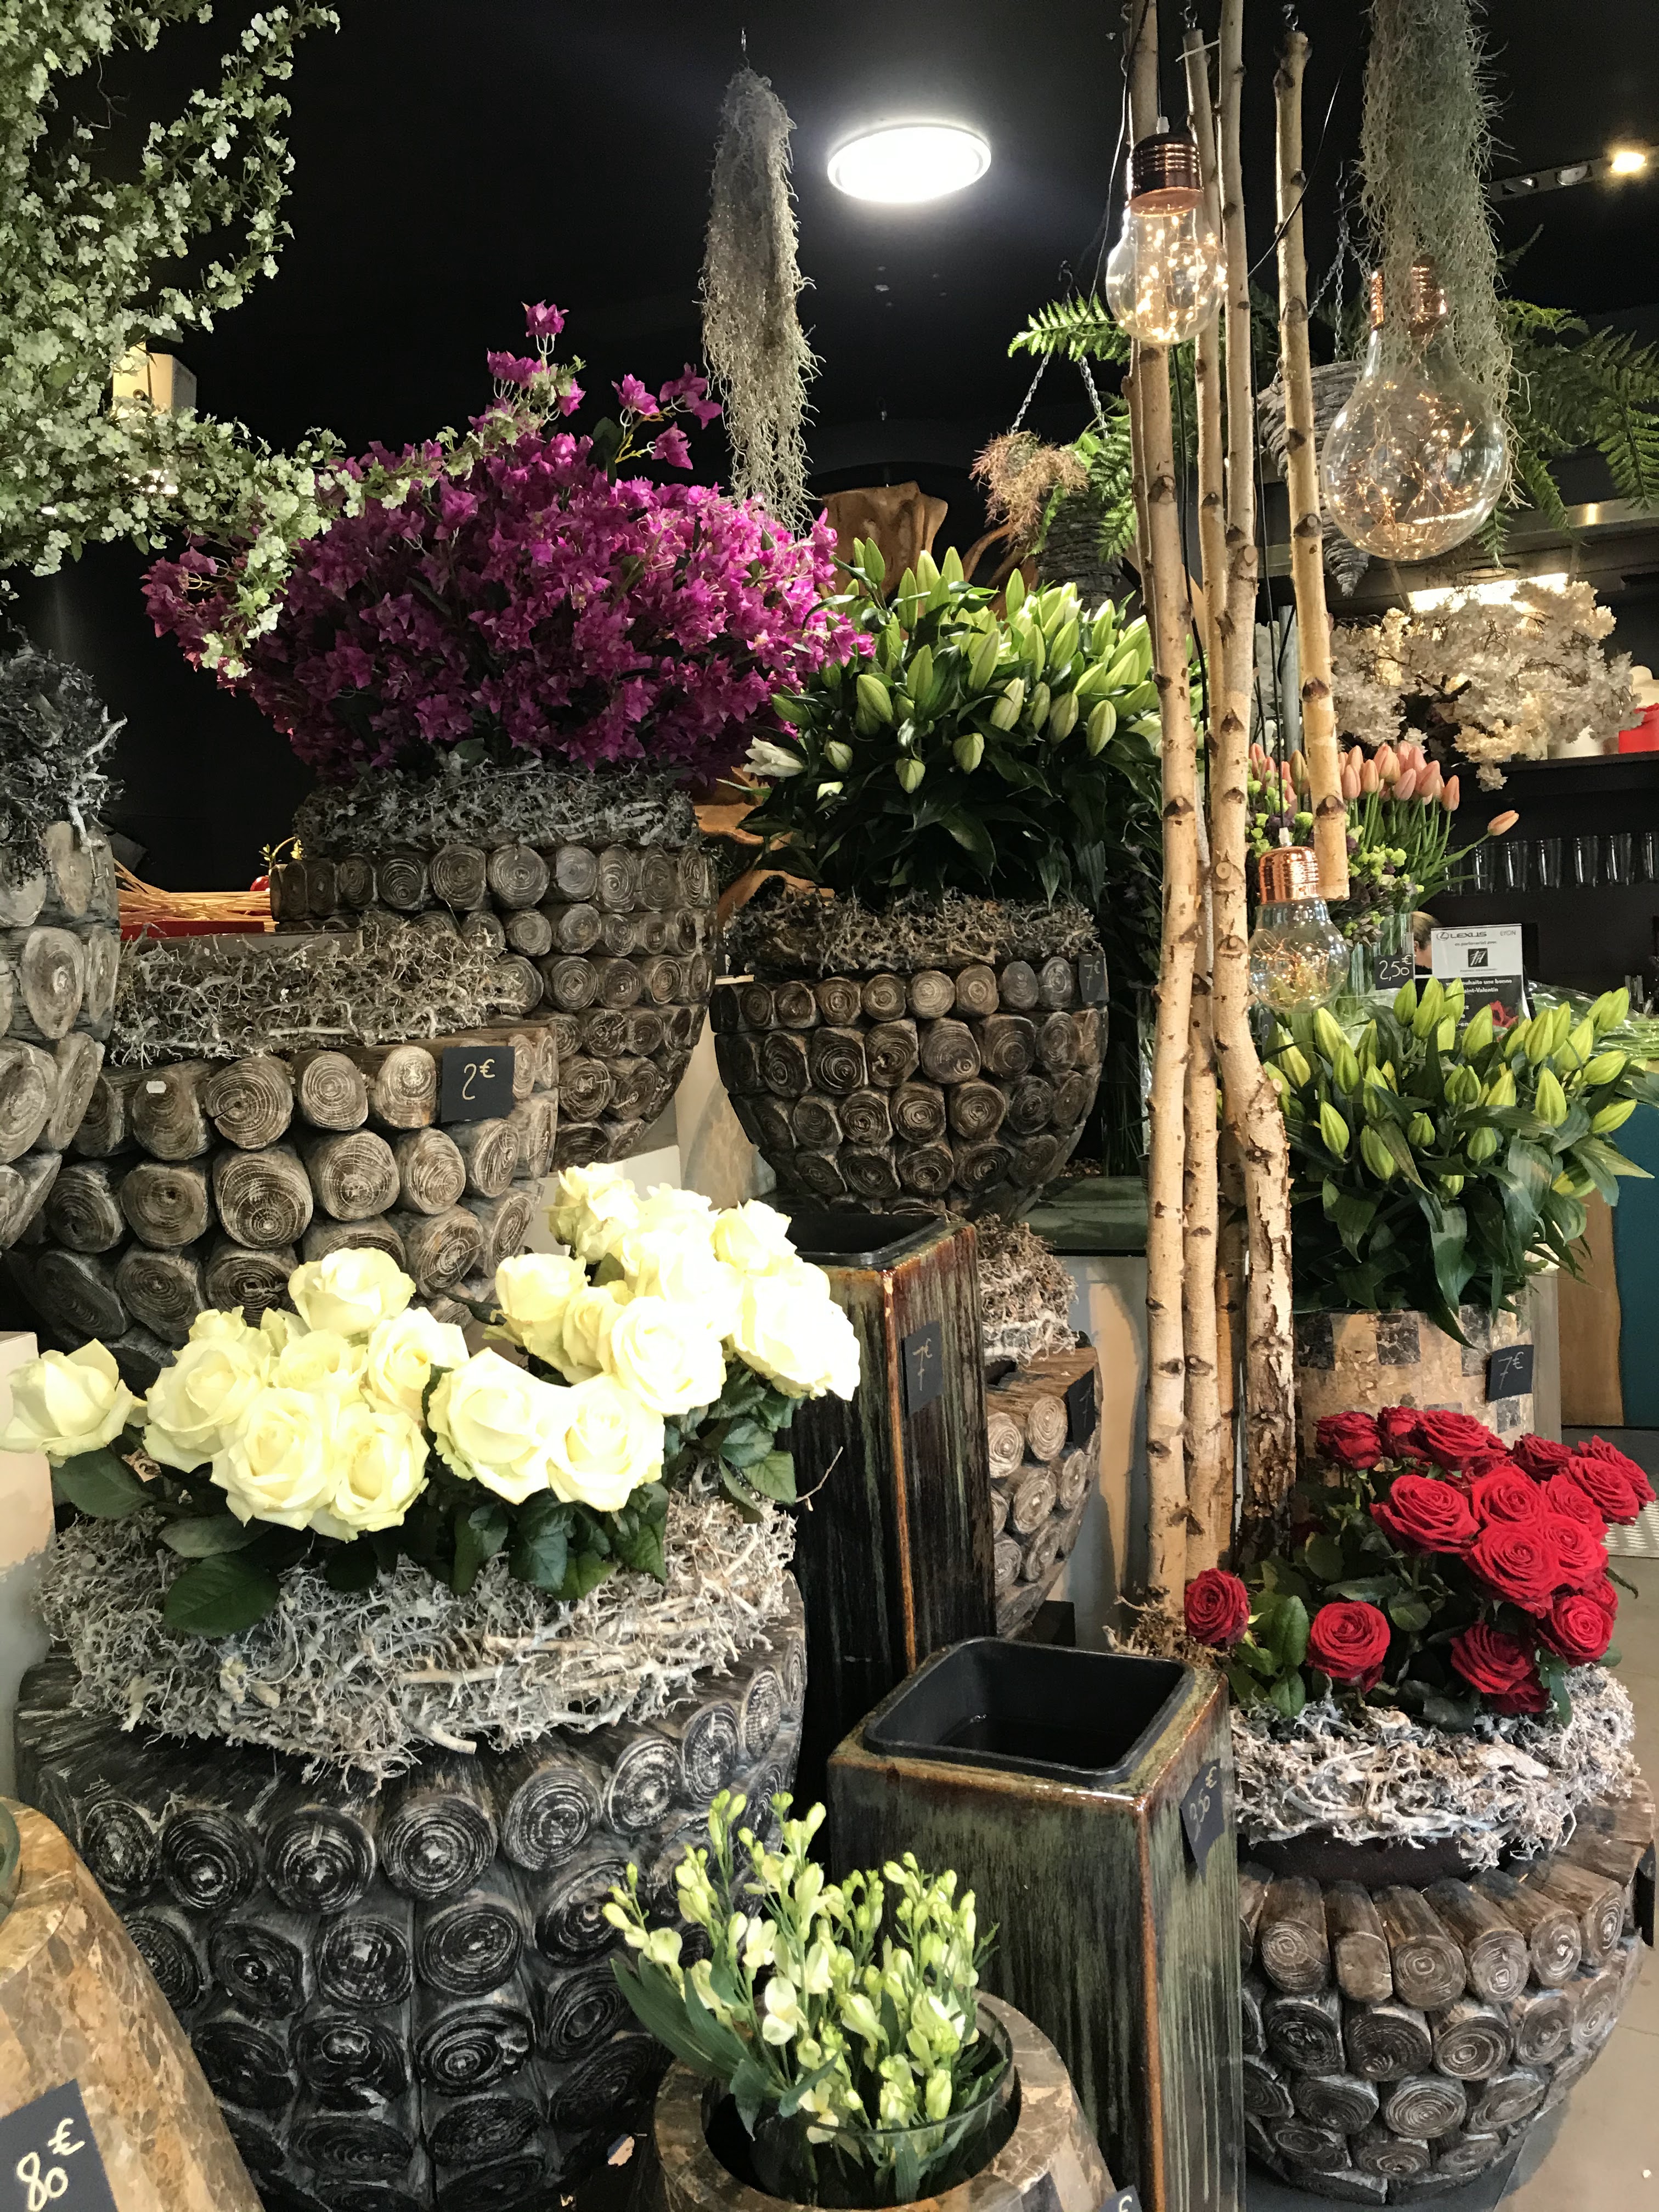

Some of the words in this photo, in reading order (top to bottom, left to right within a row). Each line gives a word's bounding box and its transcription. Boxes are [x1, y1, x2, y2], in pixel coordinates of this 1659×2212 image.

[1379, 955, 1412, 981] 2,50€
[462, 1059, 495, 1100] 2€
[1498, 1352, 1524, 1390] 7€
[16, 2118, 86, 2211] 80€
